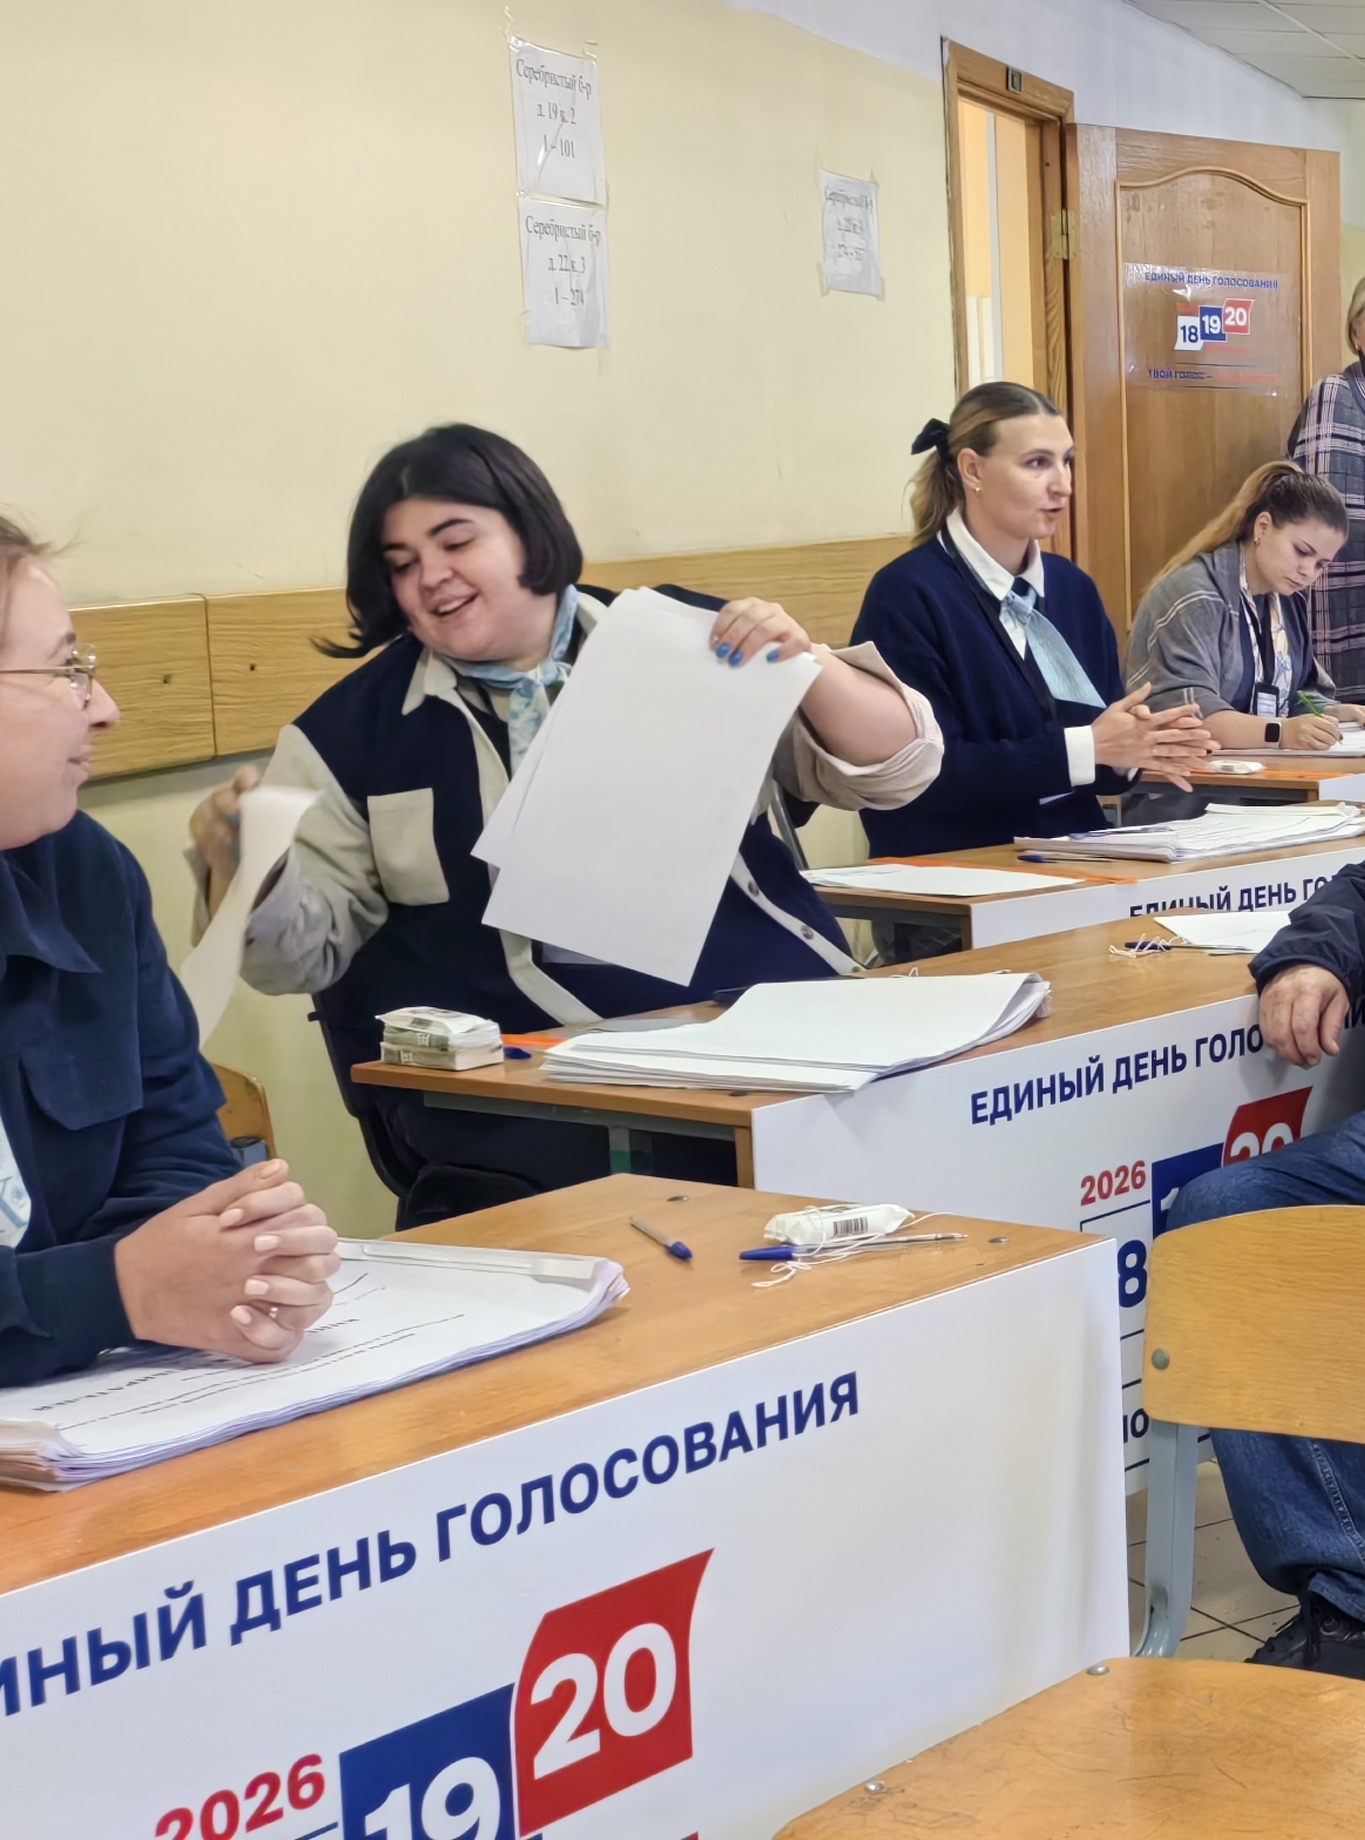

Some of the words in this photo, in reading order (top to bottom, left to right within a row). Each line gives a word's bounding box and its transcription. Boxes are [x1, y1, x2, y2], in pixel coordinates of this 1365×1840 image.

[1187, 275, 1211, 285] ДЕНЬ
[1180, 325, 1199, 343] 18
[1202, 315, 1221, 334] 19
[1225, 307, 1247, 326] 20
[1238, 882, 1297, 913] ДЕНЬ
[970, 1055, 1104, 1126] ЕДИНЫЙ
[1112, 1044, 1188, 1095] ДЕНЬ
[1080, 1160, 1147, 1206] 2026
[1117, 1239, 1148, 1309] 8
[229, 1530, 417, 1646] ДЕНЬ
[436, 1371, 860, 1562] ГОЛОСОВАНИЯ
[530, 1622, 677, 1780] 20
[153, 1753, 326, 1840] 2026
[364, 1756, 500, 1840] 19
